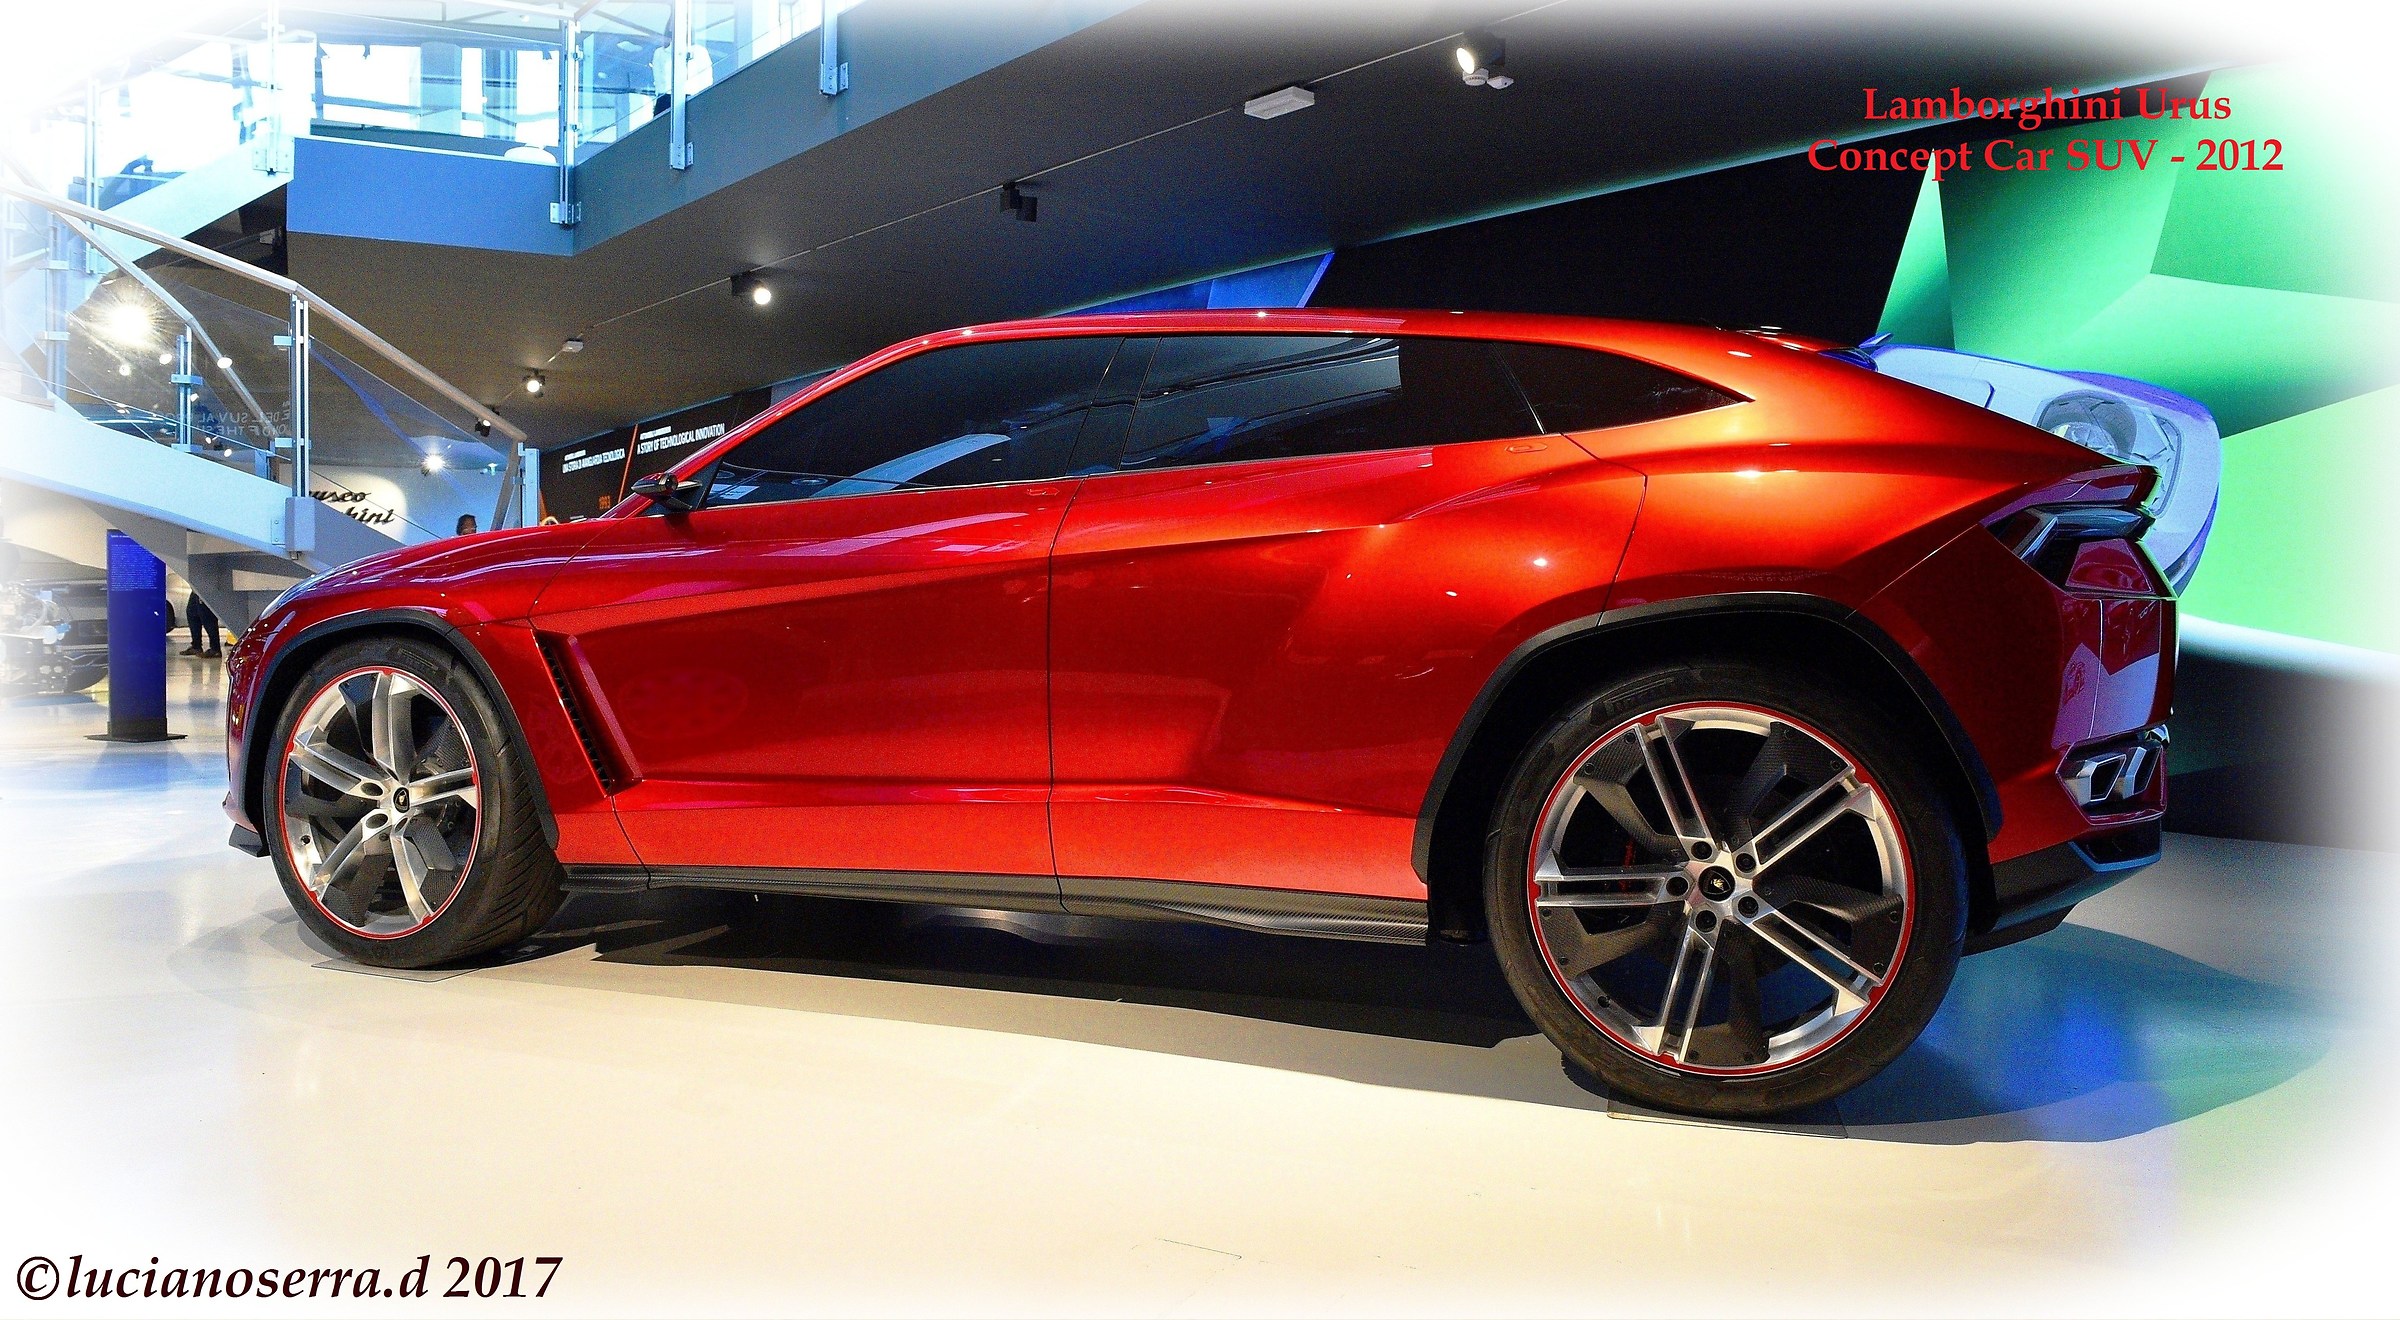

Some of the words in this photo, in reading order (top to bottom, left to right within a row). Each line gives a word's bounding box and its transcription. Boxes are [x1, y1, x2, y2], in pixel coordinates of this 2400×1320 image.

[641, 440, 653, 454] STORY
[653, 439, 660, 451] OF
[660, 429, 695, 450] TECHNOLOGICAL
[695, 422, 726, 442] INNOVATION
